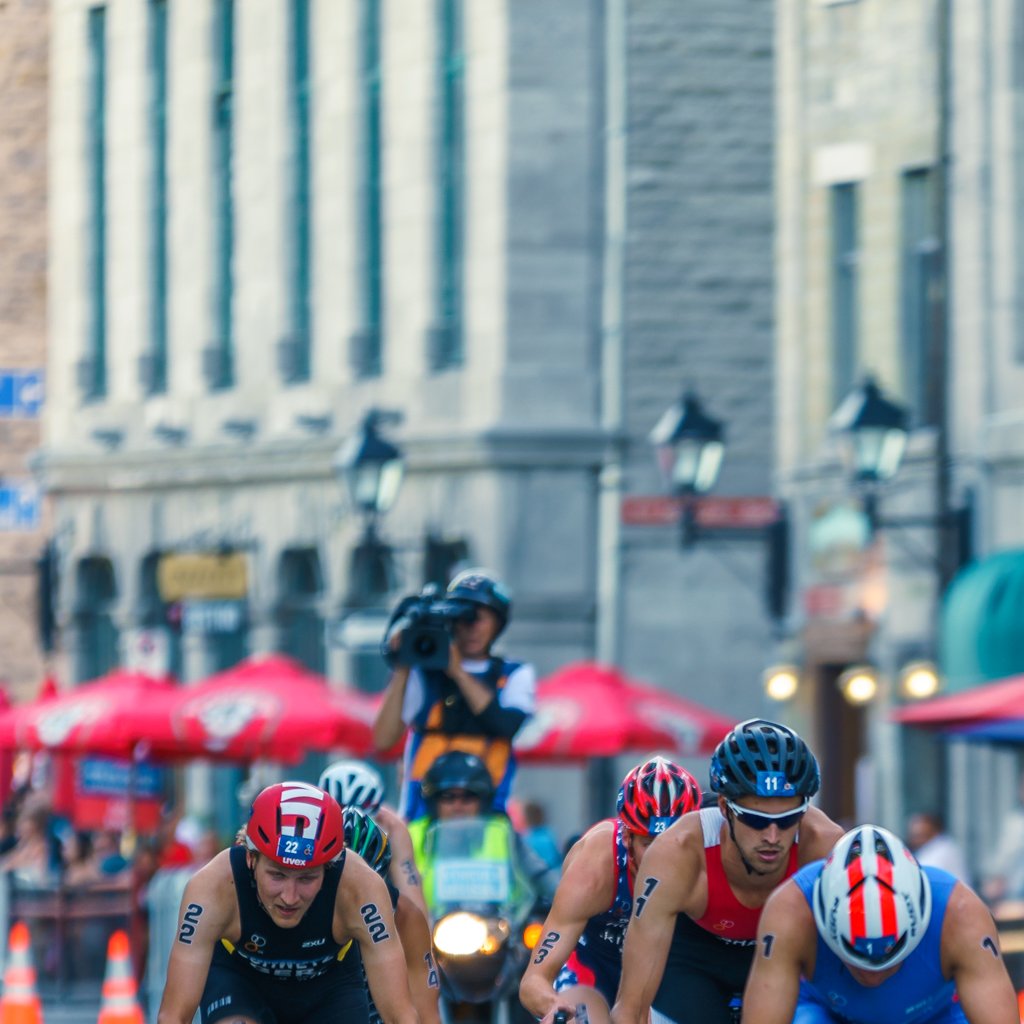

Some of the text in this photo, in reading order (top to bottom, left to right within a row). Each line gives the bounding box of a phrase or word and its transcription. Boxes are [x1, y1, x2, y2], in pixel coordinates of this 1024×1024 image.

[764, 776, 778, 791] 11
[653, 821, 666, 833] 23
[284, 840, 299, 854] 22
[282, 857, 306, 866] uvex
[178, 902, 204, 945] 22
[360, 902, 390, 944] 22
[301, 938, 326, 949] 2XU
[533, 931, 561, 965] 23
[762, 934, 775, 958] 1
[866, 943, 873, 956] 1
[982, 935, 999, 958] 1
